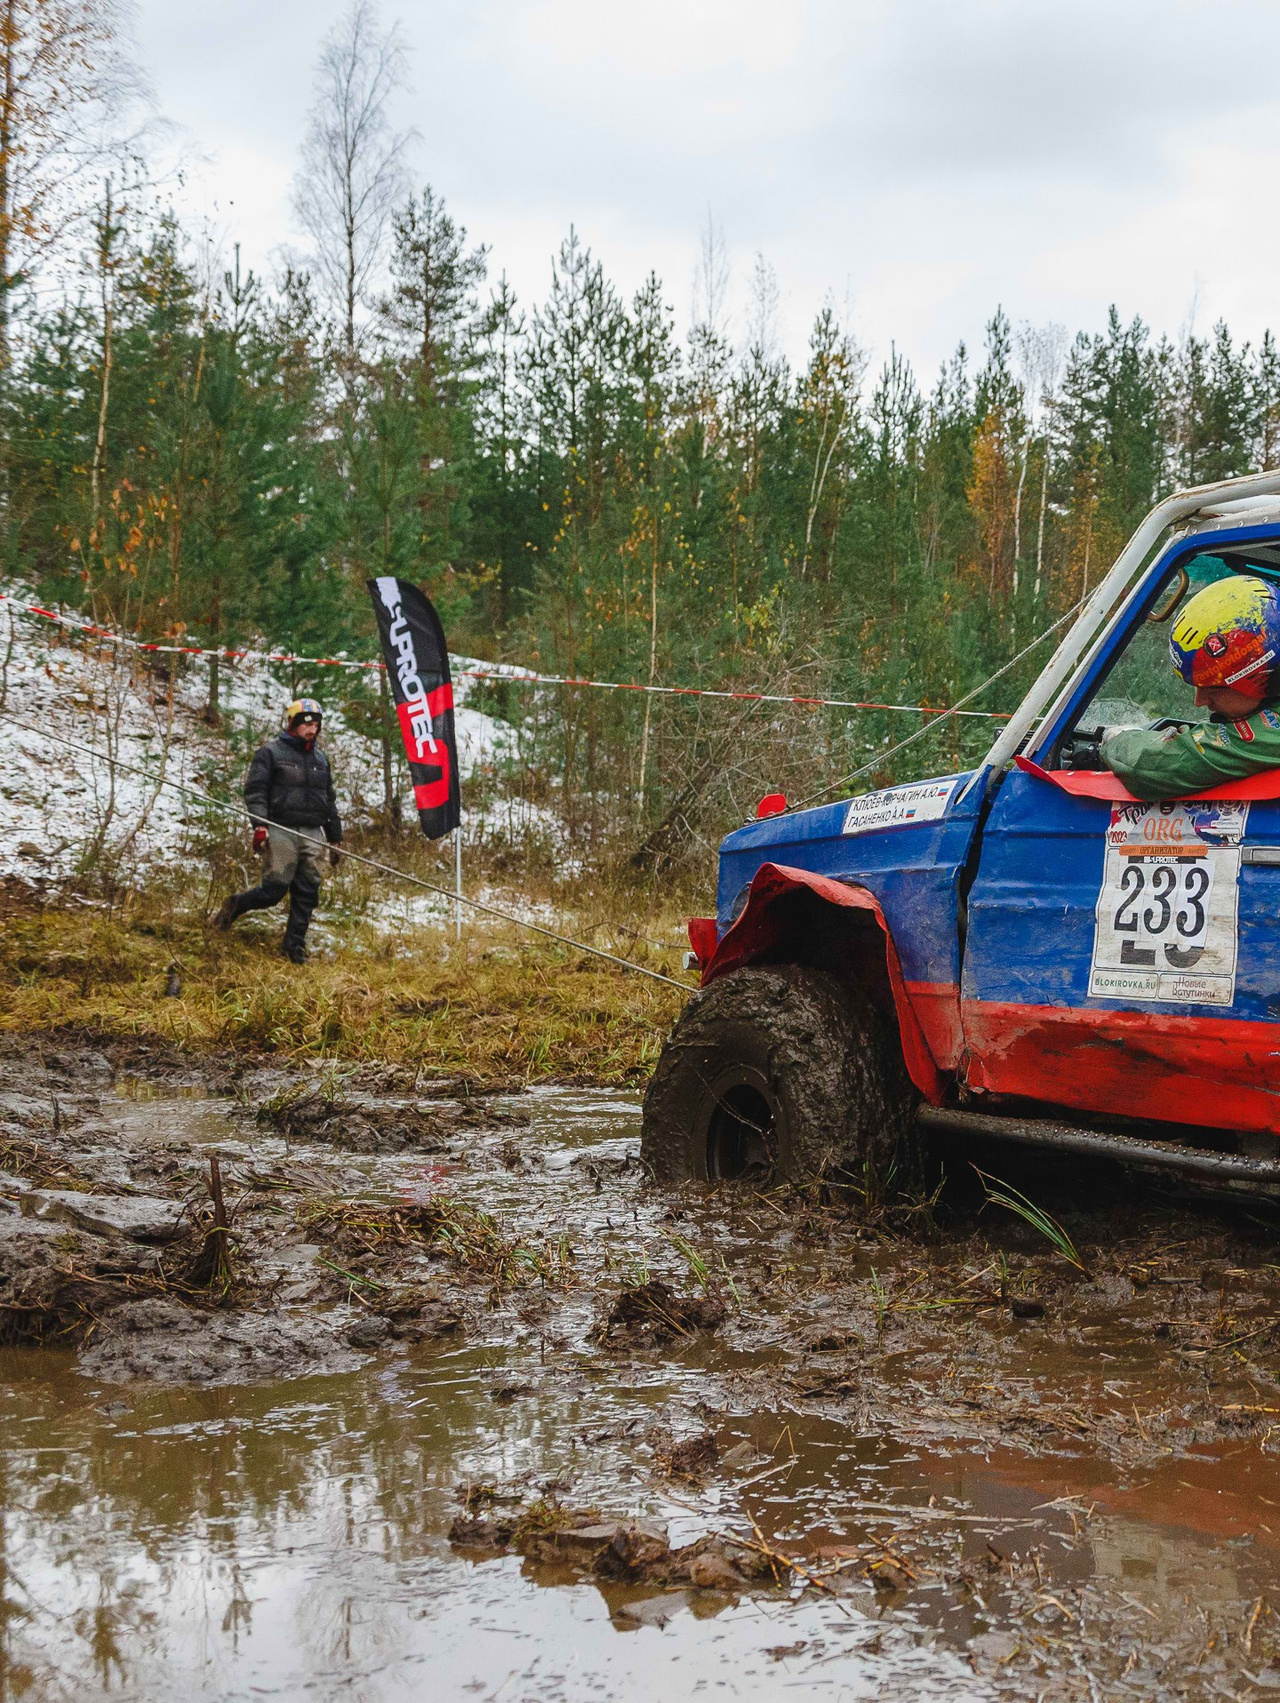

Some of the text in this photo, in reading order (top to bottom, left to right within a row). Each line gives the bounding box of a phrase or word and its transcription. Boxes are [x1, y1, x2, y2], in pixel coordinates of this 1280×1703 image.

[385, 600, 438, 759] SUPROTEC
[1227, 651, 1274, 683] BLOKIROVKA.RU
[847, 810, 892, 828] ГАСАНЕНКО
[1143, 817, 1184, 842] ORG
[1140, 846, 1184, 855] ОРГАНИЗАТОР
[1114, 865, 1210, 938] 233
[1094, 977, 1156, 990] BLOKIROVKA.RU
